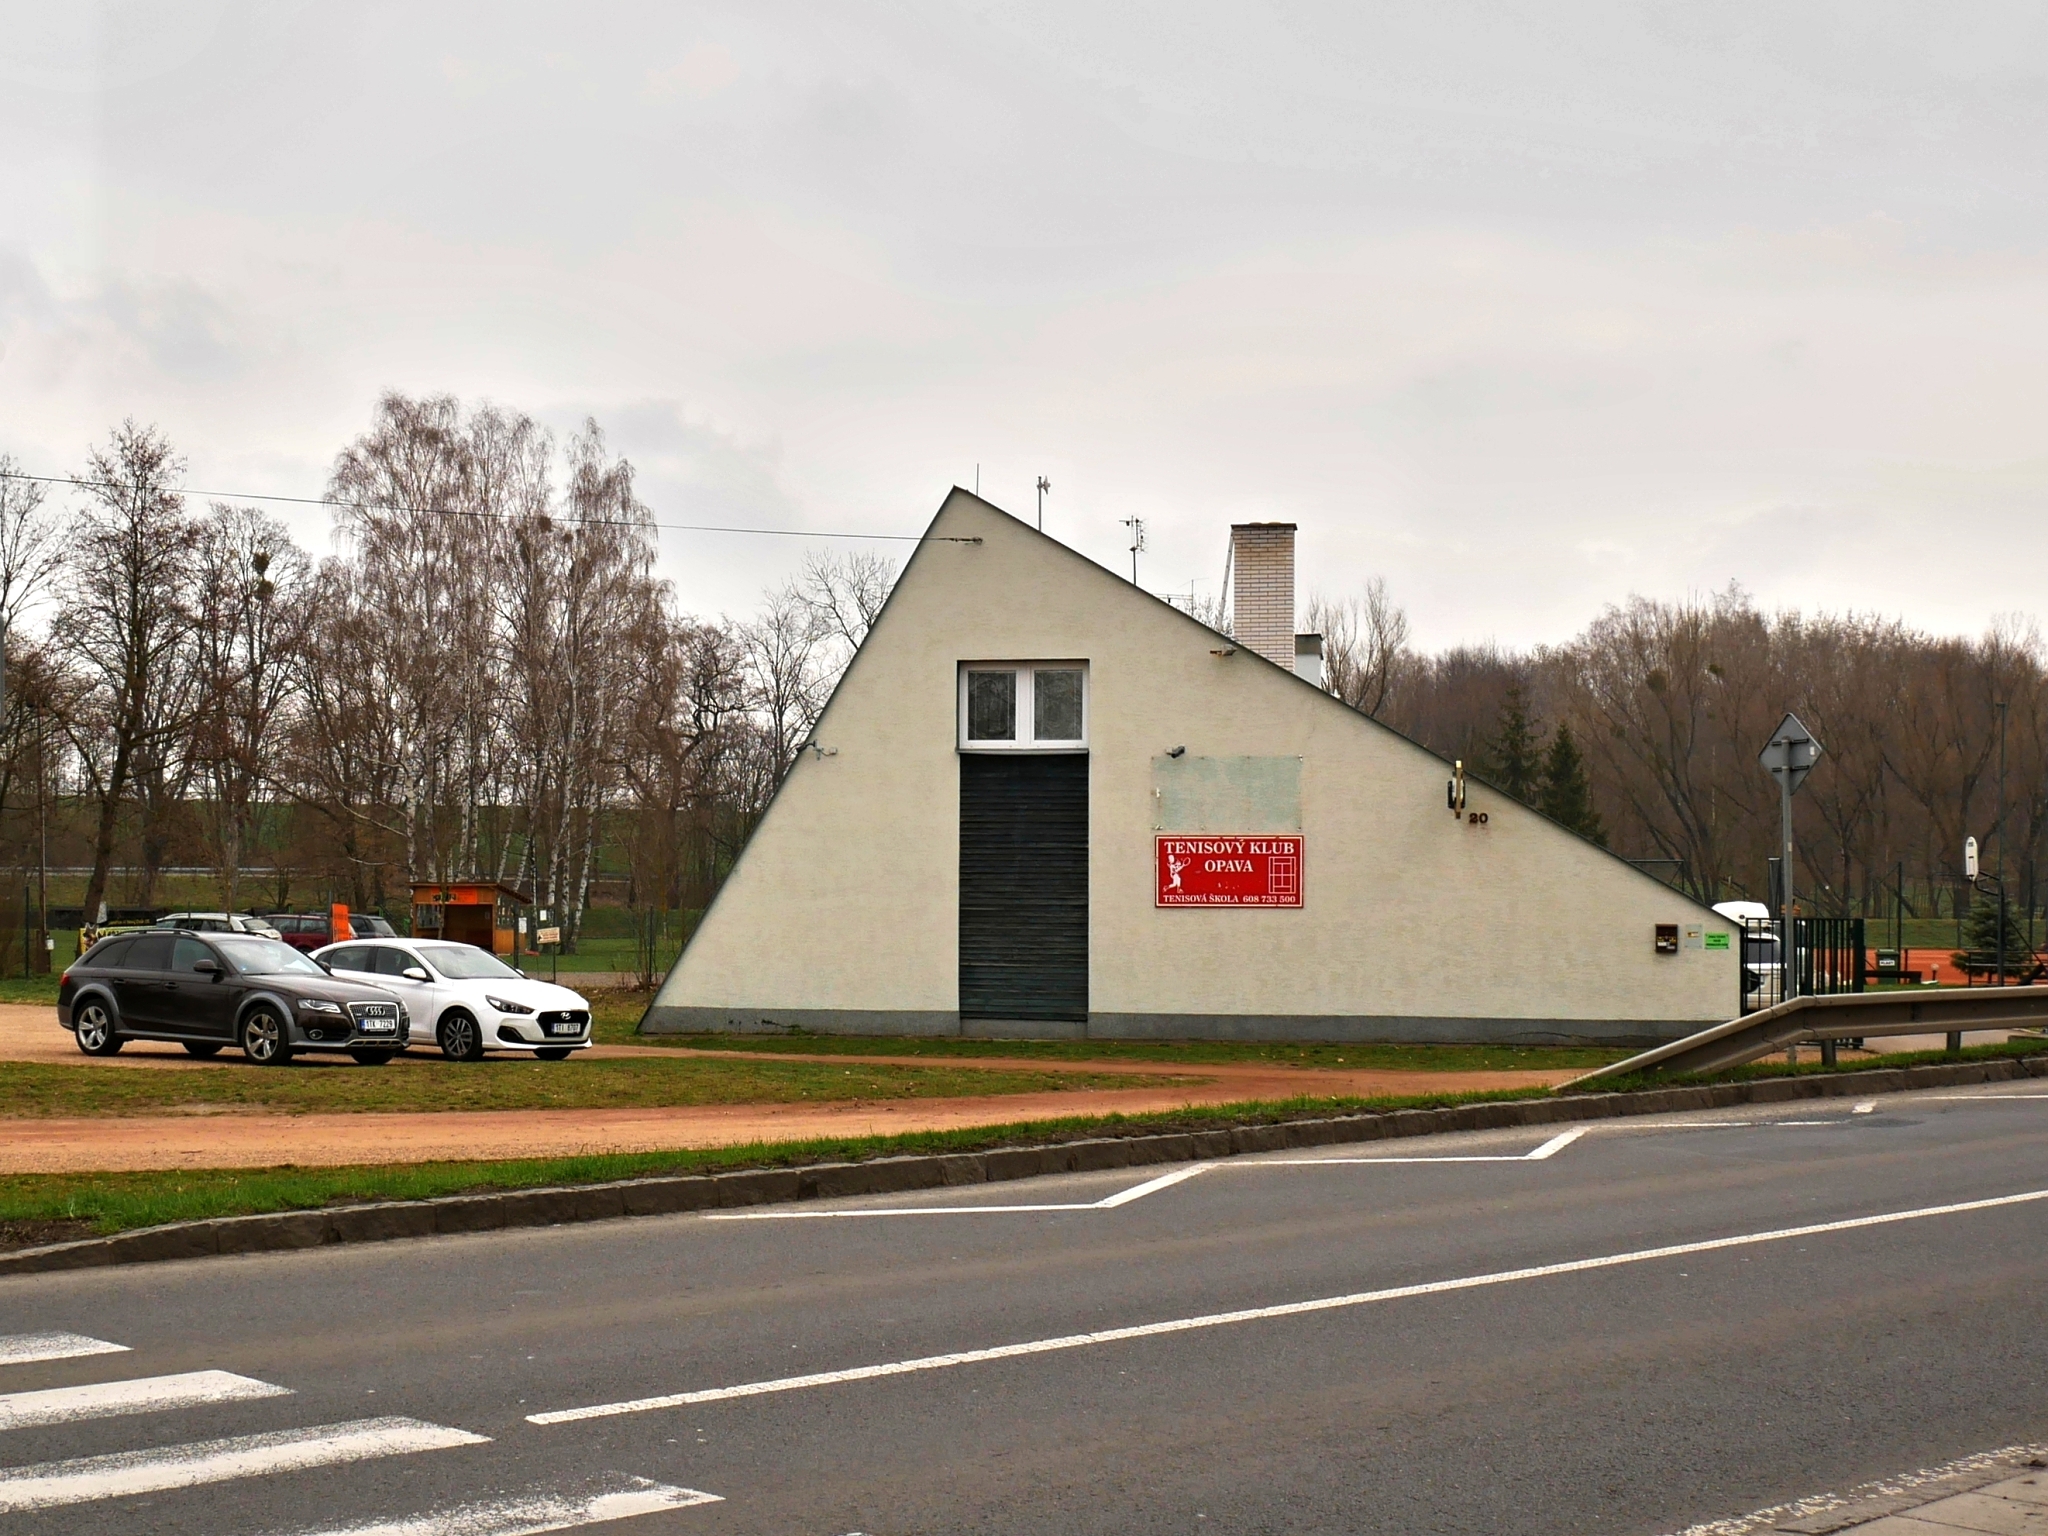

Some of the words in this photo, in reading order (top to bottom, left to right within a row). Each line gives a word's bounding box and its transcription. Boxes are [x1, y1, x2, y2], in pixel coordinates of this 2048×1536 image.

[1469, 813, 1488, 823] 20
[1164, 838, 1246, 854] TENISOVÝ
[1249, 842, 1295, 854] KLUB
[1204, 860, 1254, 872] OPAVA
[1163, 893, 1207, 903] TENISOVÁ
[1209, 893, 1239, 903] ŠKOLA
[1242, 895, 1260, 903] 608
[1261, 895, 1278, 903] 733
[1279, 895, 1296, 903] 500
